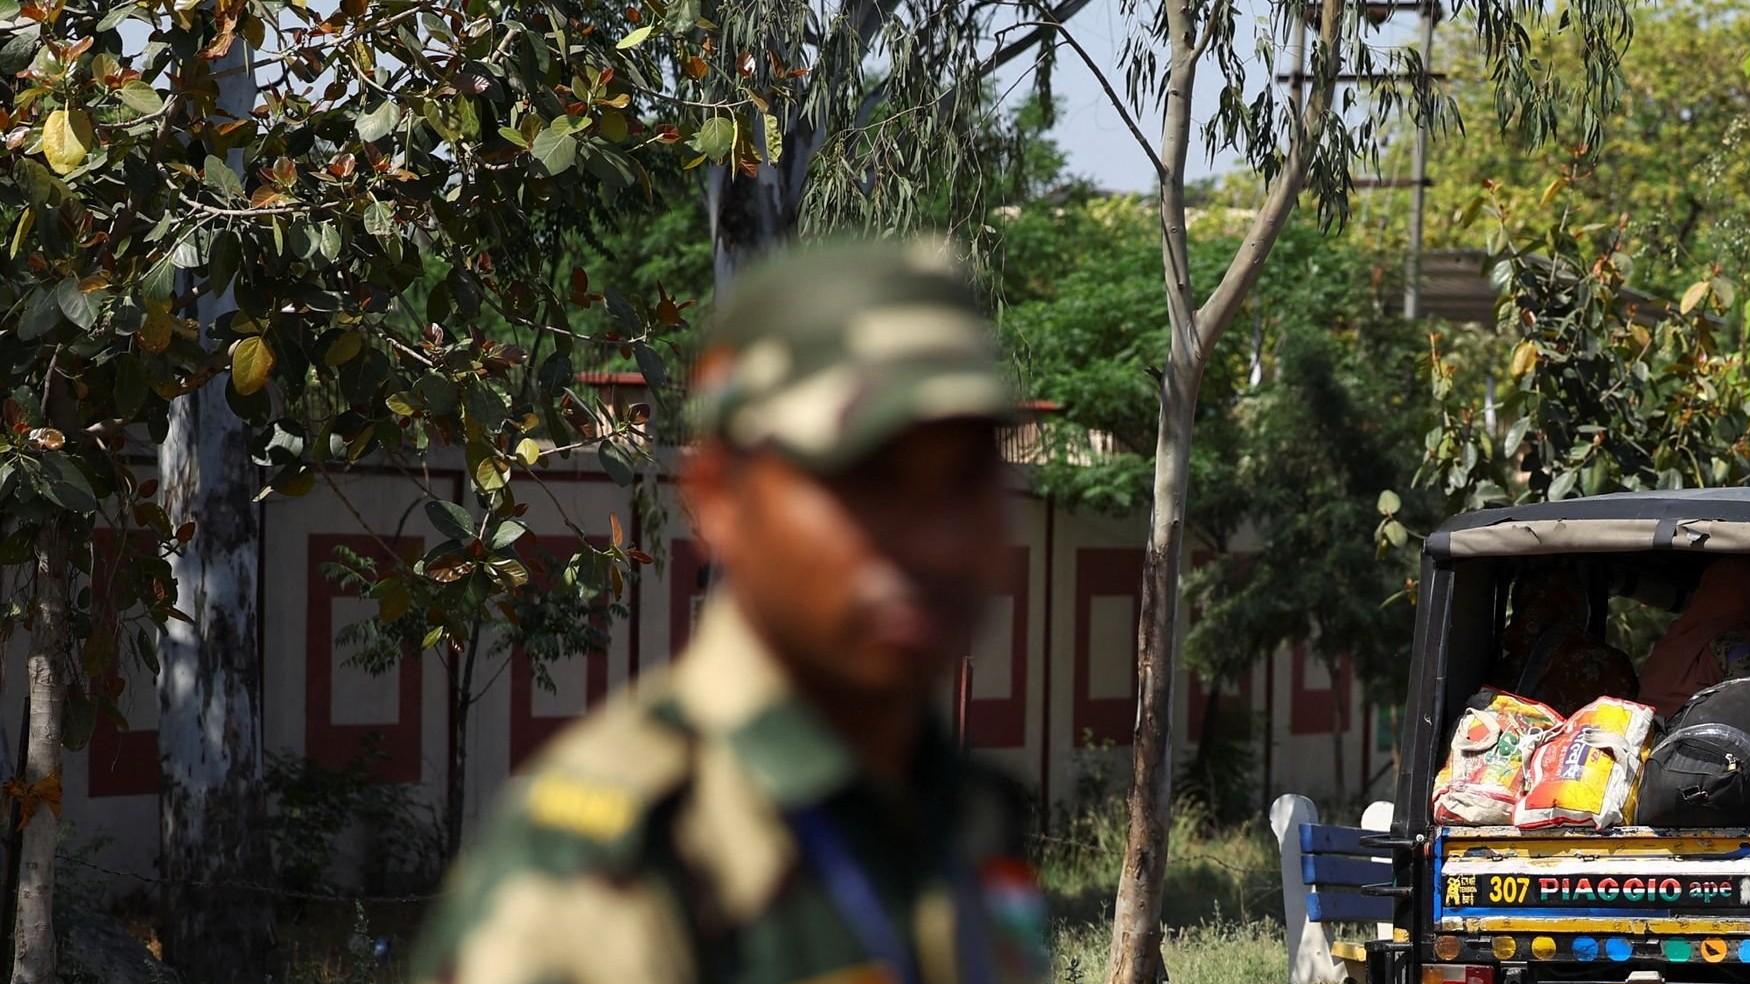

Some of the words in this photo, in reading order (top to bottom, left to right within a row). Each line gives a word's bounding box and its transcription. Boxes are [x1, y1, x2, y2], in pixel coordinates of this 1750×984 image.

[1489, 875, 1530, 903] 307
[1538, 877, 1682, 903] PIAGGIO
[1689, 881, 1733, 903] ape
